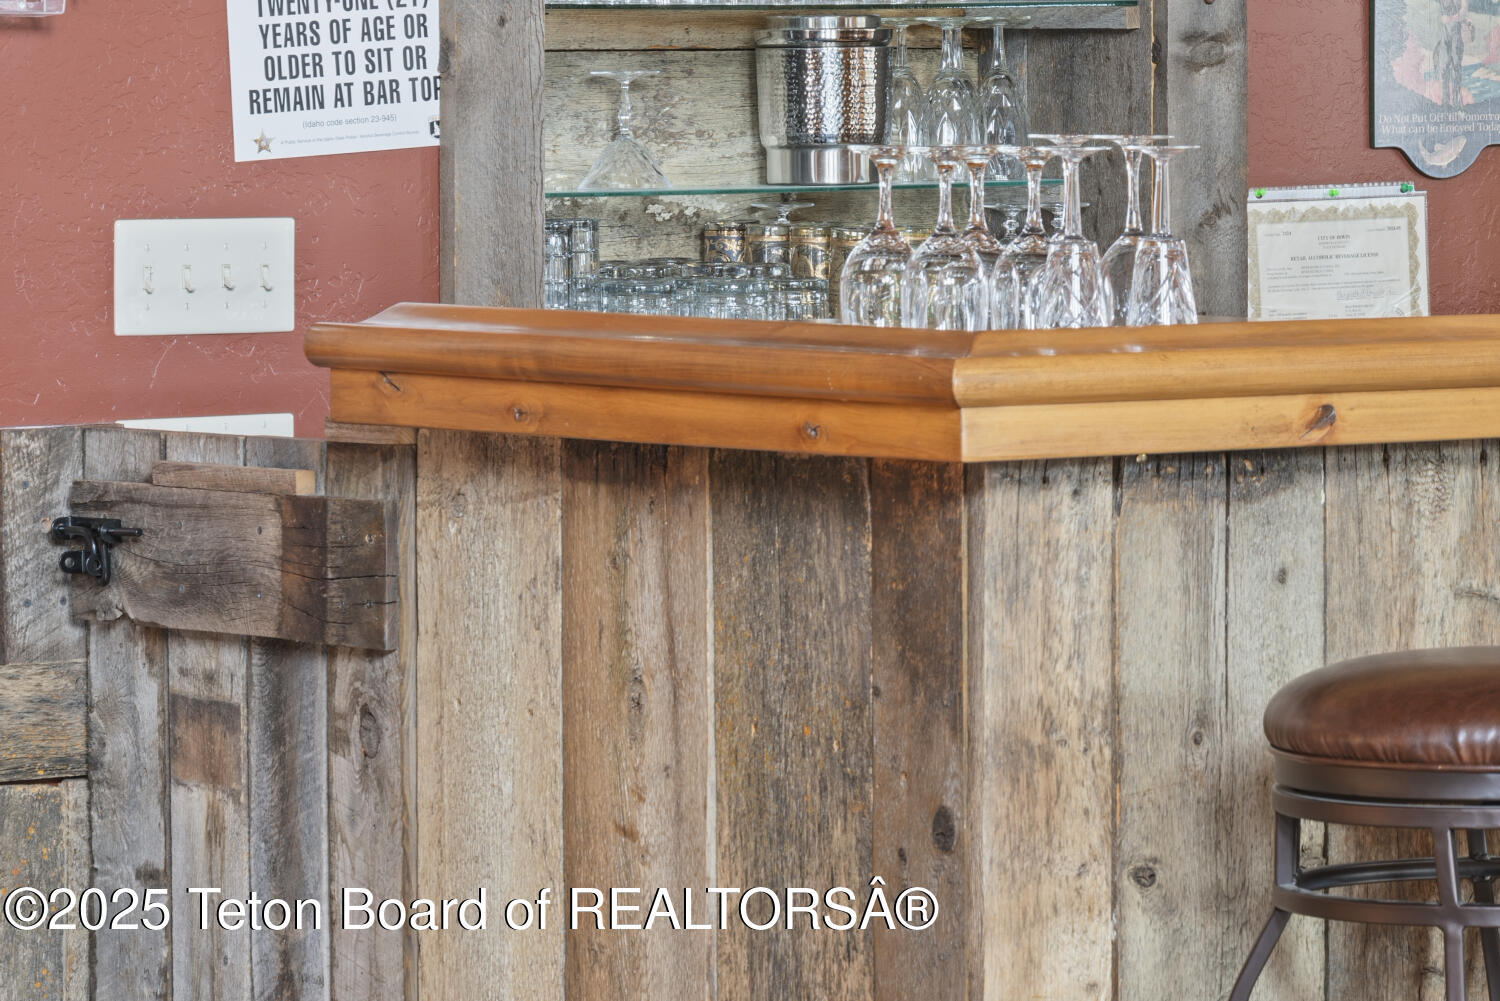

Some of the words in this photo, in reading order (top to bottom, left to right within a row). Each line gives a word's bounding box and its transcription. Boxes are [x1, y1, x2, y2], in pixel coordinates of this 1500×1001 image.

[258, 20, 321, 50] YEARS
[329, 18, 352, 45] OF
[361, 15, 396, 43] AGE
[403, 13, 428, 40] OR
[264, 52, 324, 82] OLDER
[332, 49, 356, 77] TO
[364, 47, 394, 74] SIT
[402, 45, 427, 71] OR
[249, 84, 325, 115] REMAIN
[333, 82, 354, 109] AT
[363, 78, 401, 106] BAR
[327, 118, 343, 127] code
[345, 115, 370, 126] section
